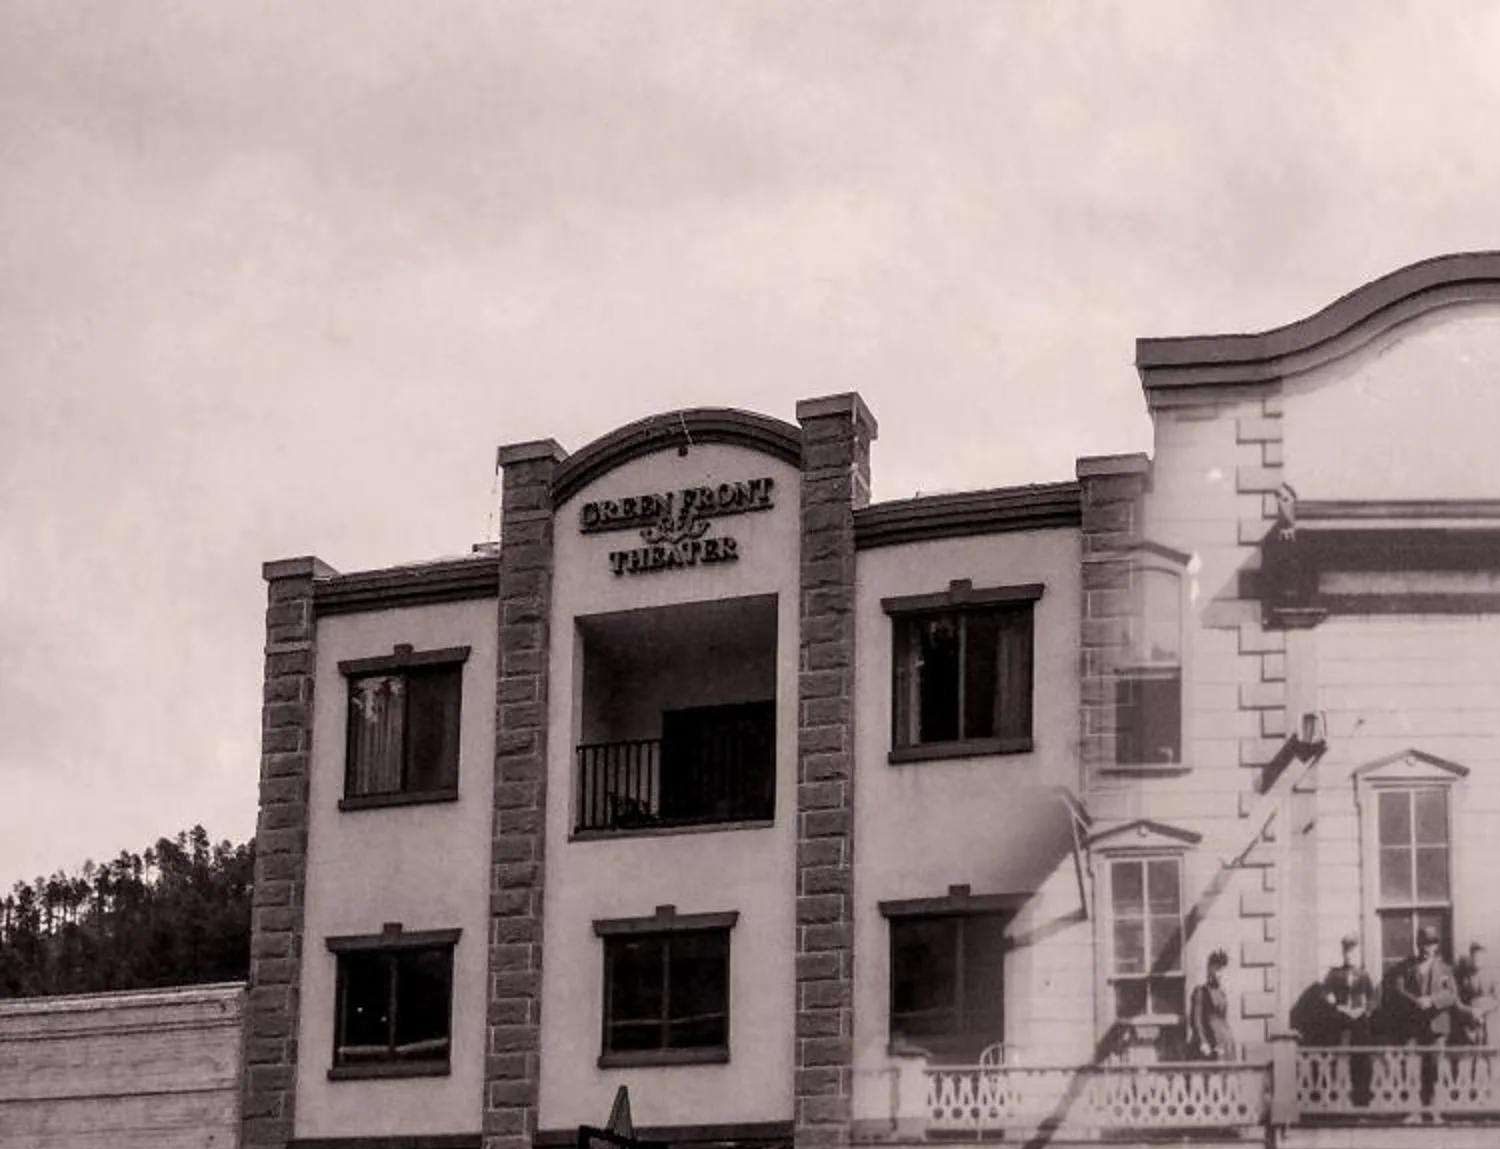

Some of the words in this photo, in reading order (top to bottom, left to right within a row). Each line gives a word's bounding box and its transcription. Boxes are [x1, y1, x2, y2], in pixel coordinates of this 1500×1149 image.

[580, 492, 674, 527] GREEN
[679, 477, 775, 520] FRONT
[609, 537, 740, 576] THEATER
